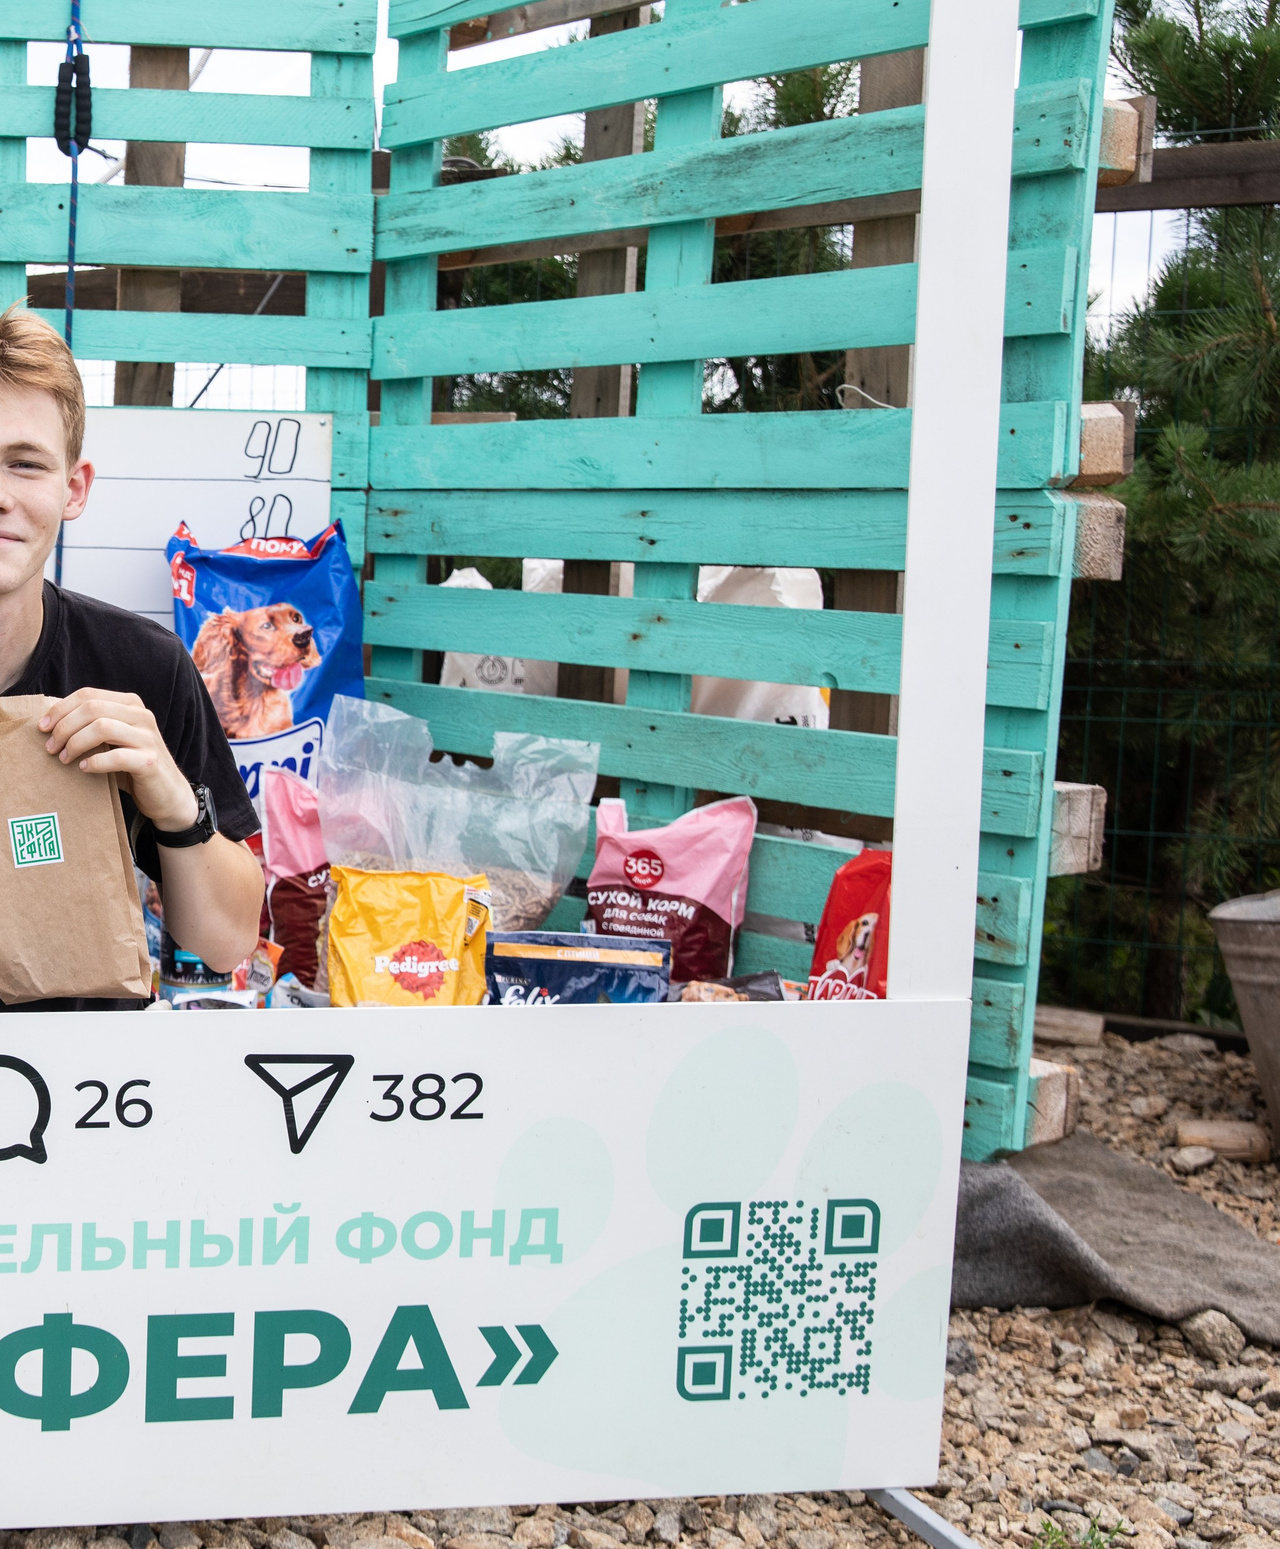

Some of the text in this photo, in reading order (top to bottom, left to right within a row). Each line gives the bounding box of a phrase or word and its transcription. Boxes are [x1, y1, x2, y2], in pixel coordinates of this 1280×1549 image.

[243, 418, 301, 479] 90
[624, 856, 663, 877] 365
[588, 891, 696, 920] СУХОЙ КОРМ
[602, 907, 668, 926] ДЛЯ СОБАК
[374, 956, 460, 978] Pedigree
[74, 1079, 153, 1129] 26
[369, 1072, 484, 1122] 382
[334, 1206, 565, 1267] ФОНД
